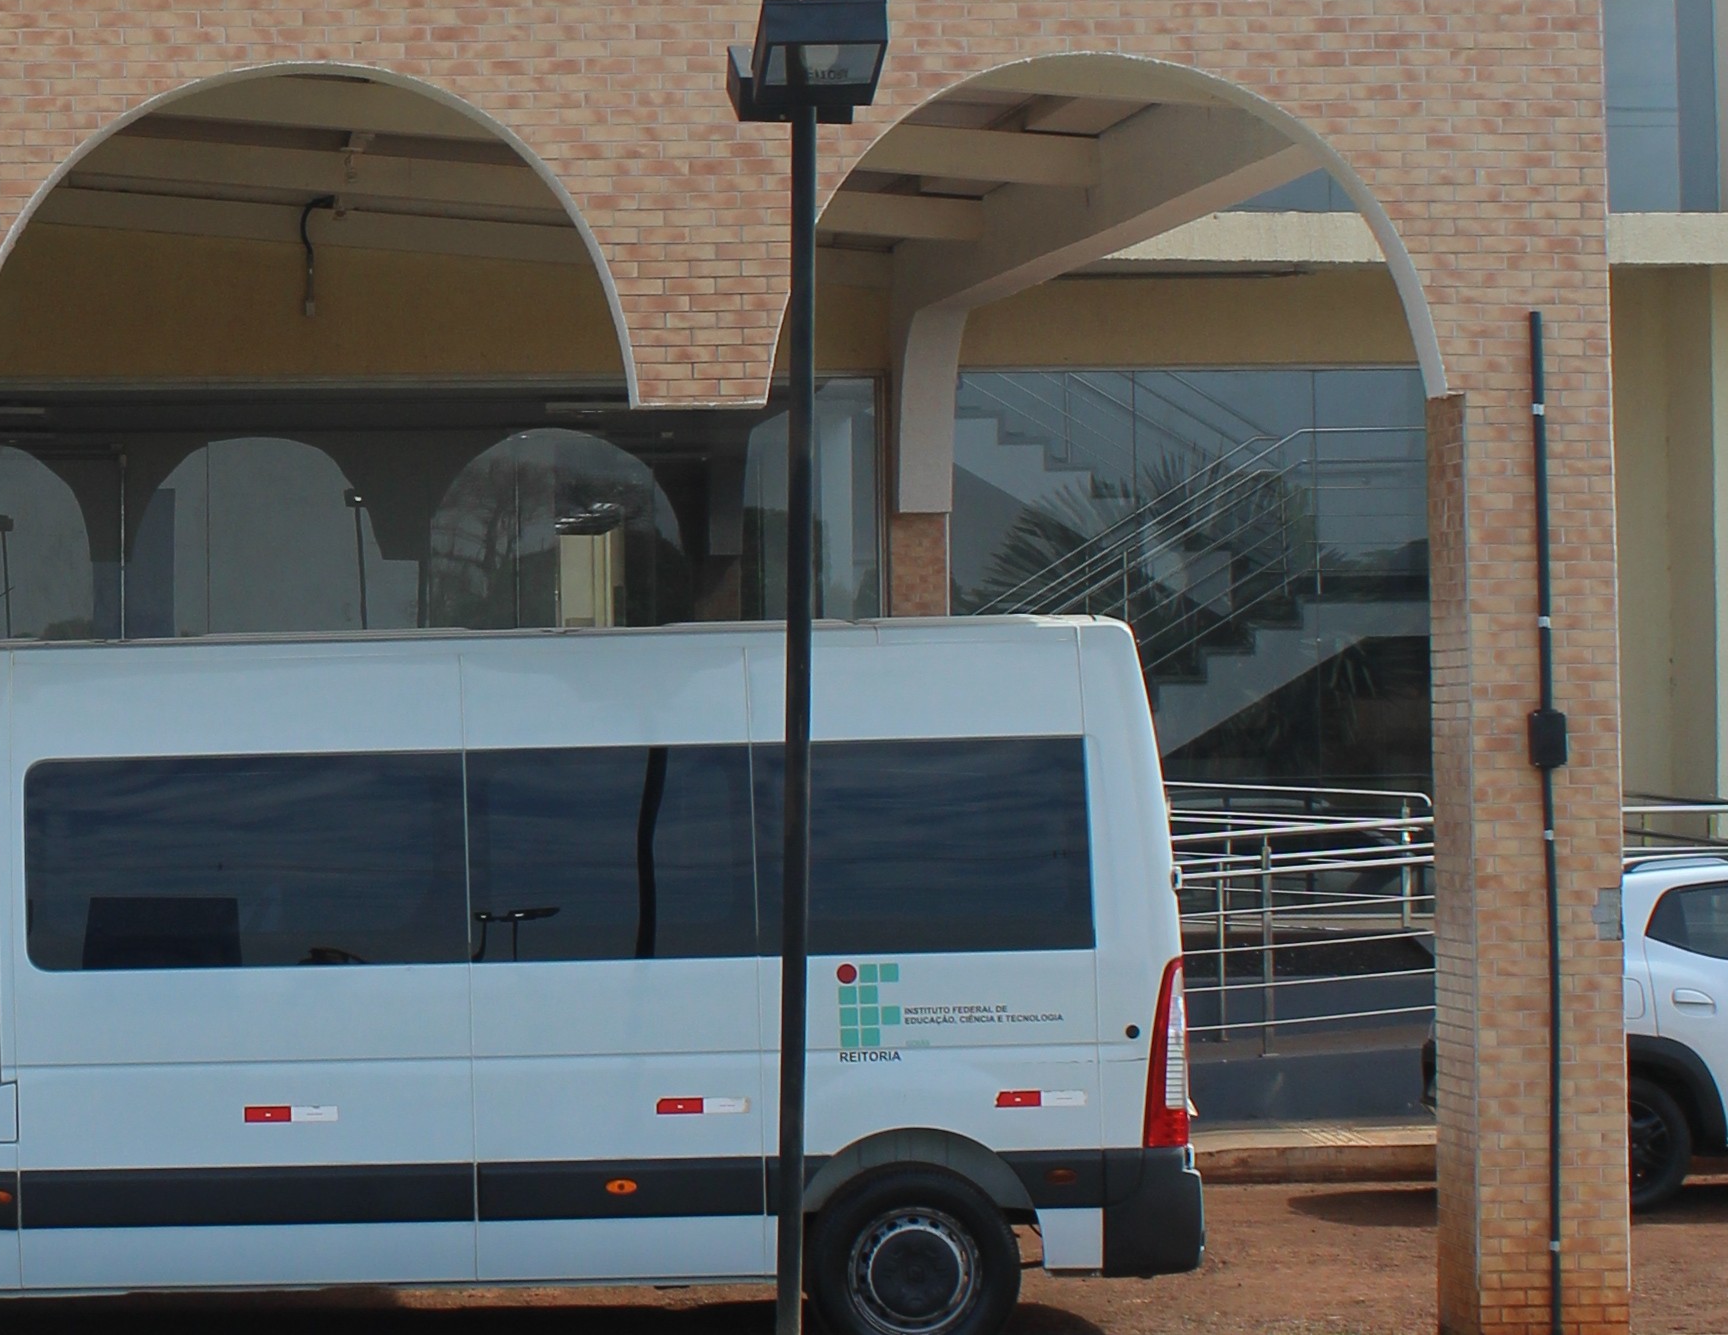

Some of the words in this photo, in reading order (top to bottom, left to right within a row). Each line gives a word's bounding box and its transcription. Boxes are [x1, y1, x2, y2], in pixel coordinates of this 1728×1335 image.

[904, 1006, 950, 1015] INSTITUTO
[952, 1005, 993, 1014] FEDERAL
[995, 1005, 1007, 1014] DE
[959, 1014, 996, 1024] CIÊNCIA
[997, 1014, 1004, 1023] E
[1006, 1014, 1064, 1023] TECNOLOGIA
[839, 1050, 902, 1063] REITORIA
